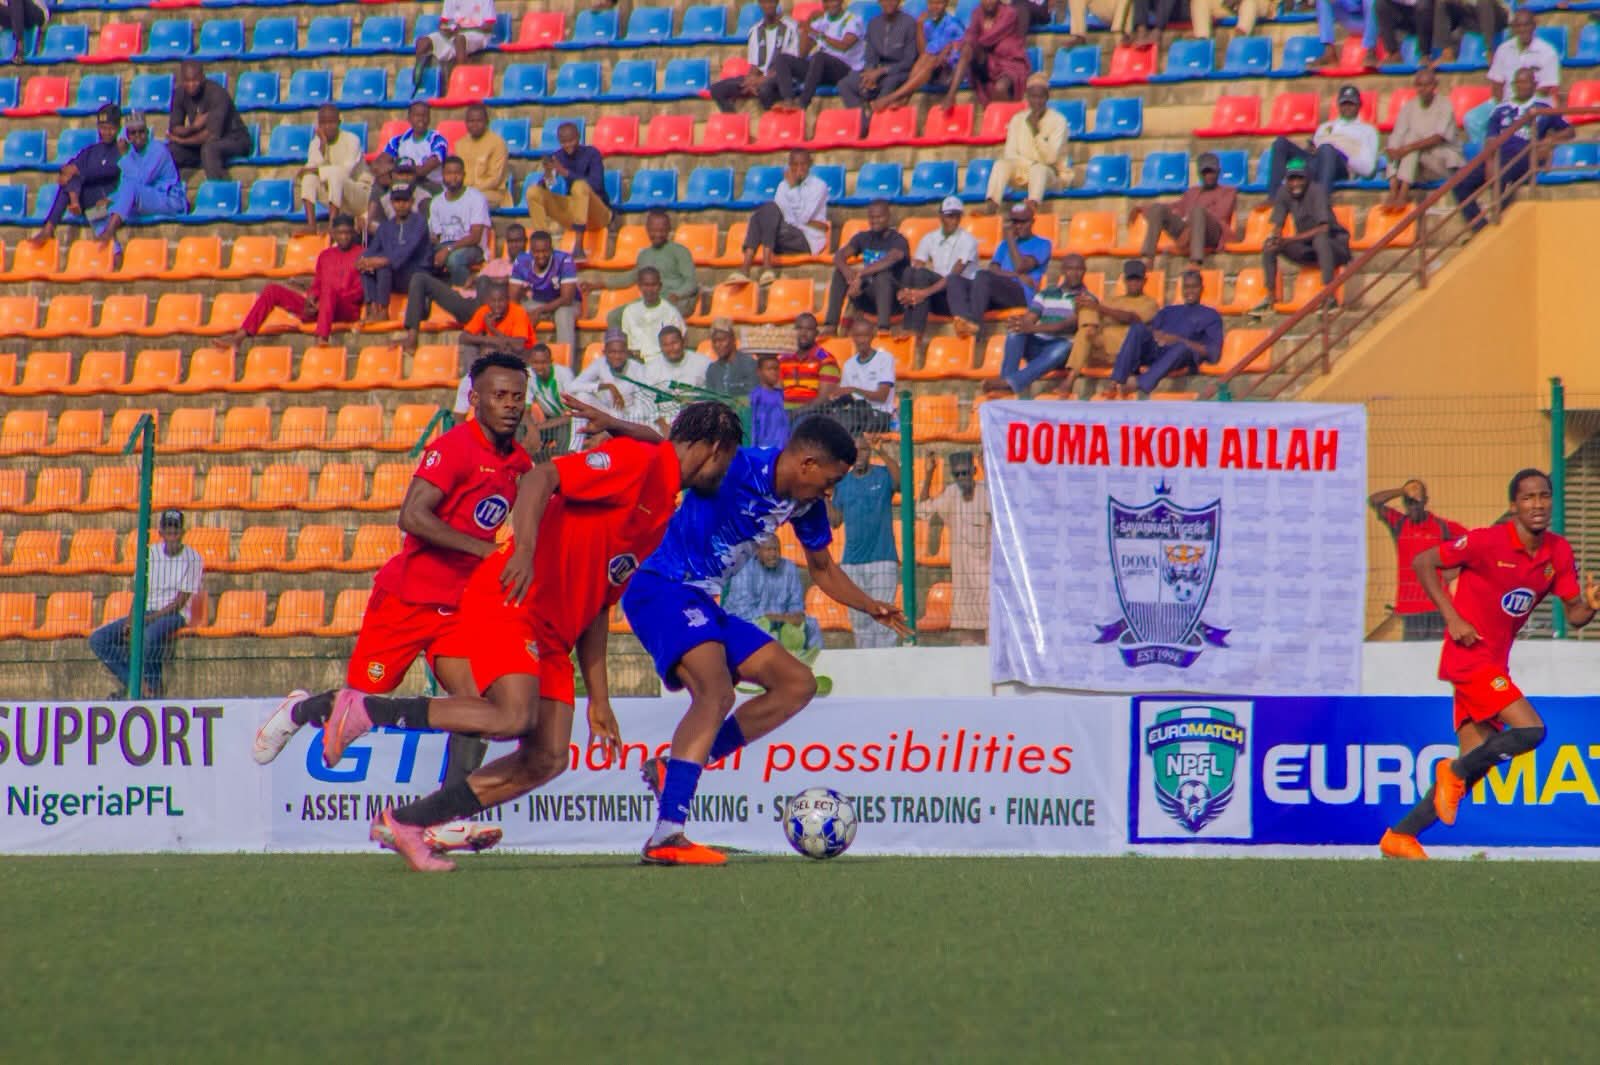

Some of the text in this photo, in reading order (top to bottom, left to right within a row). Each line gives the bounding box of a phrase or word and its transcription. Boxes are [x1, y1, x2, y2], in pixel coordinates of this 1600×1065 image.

[1007, 422, 1338, 471] DOMA IKON ALLAH
[1121, 554, 1158, 569] DOMA
[1148, 722, 1244, 745] EUROMATCH
[306, 724, 449, 784] GT
[763, 729, 1073, 782] possibilities
[1166, 754, 1223, 777] NPFL
[7, 785, 184, 825] NigeriaPFL
[301, 794, 361, 821] ASSET
[528, 794, 654, 822] INVESTMENT
[687, 795, 748, 822] NKING
[891, 796, 981, 825] TRADING
[1006, 797, 1095, 826] FINANCE
